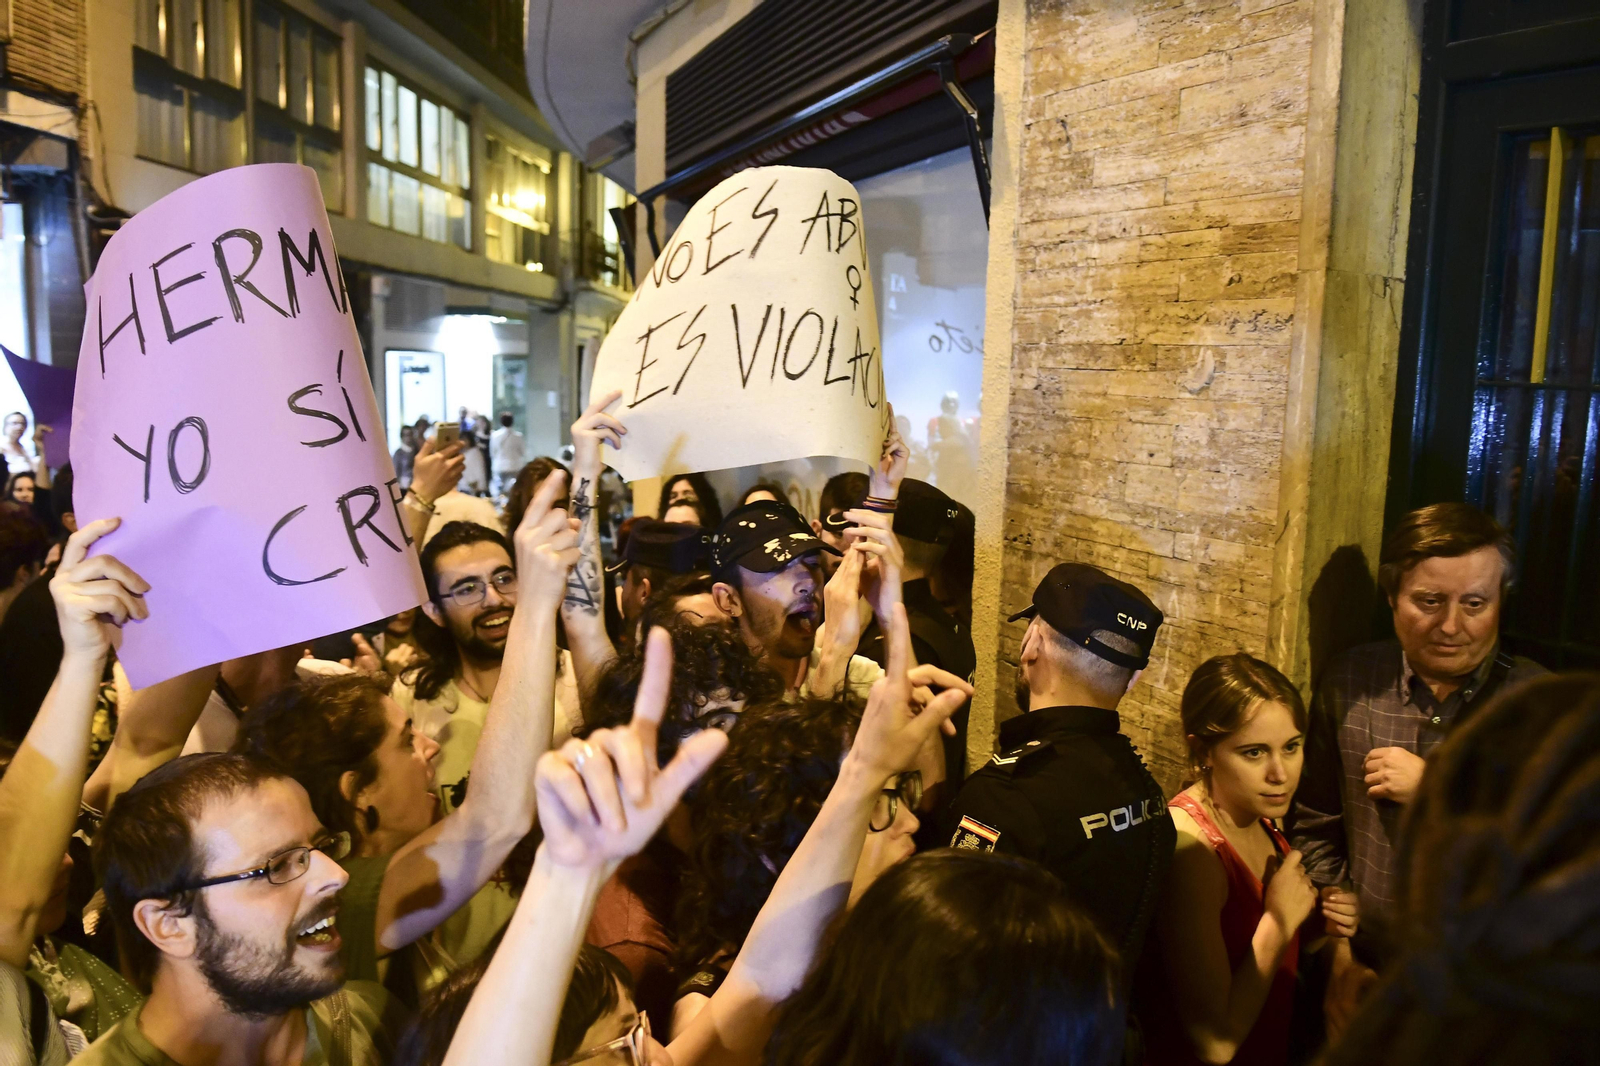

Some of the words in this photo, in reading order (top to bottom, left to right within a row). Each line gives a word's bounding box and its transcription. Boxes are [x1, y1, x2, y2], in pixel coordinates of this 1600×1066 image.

[701, 179, 779, 275] ES
[627, 304, 707, 409] ES
[112, 416, 211, 503] YO
[287, 349, 367, 448] SÍ
[1116, 612, 1148, 631] CNP
